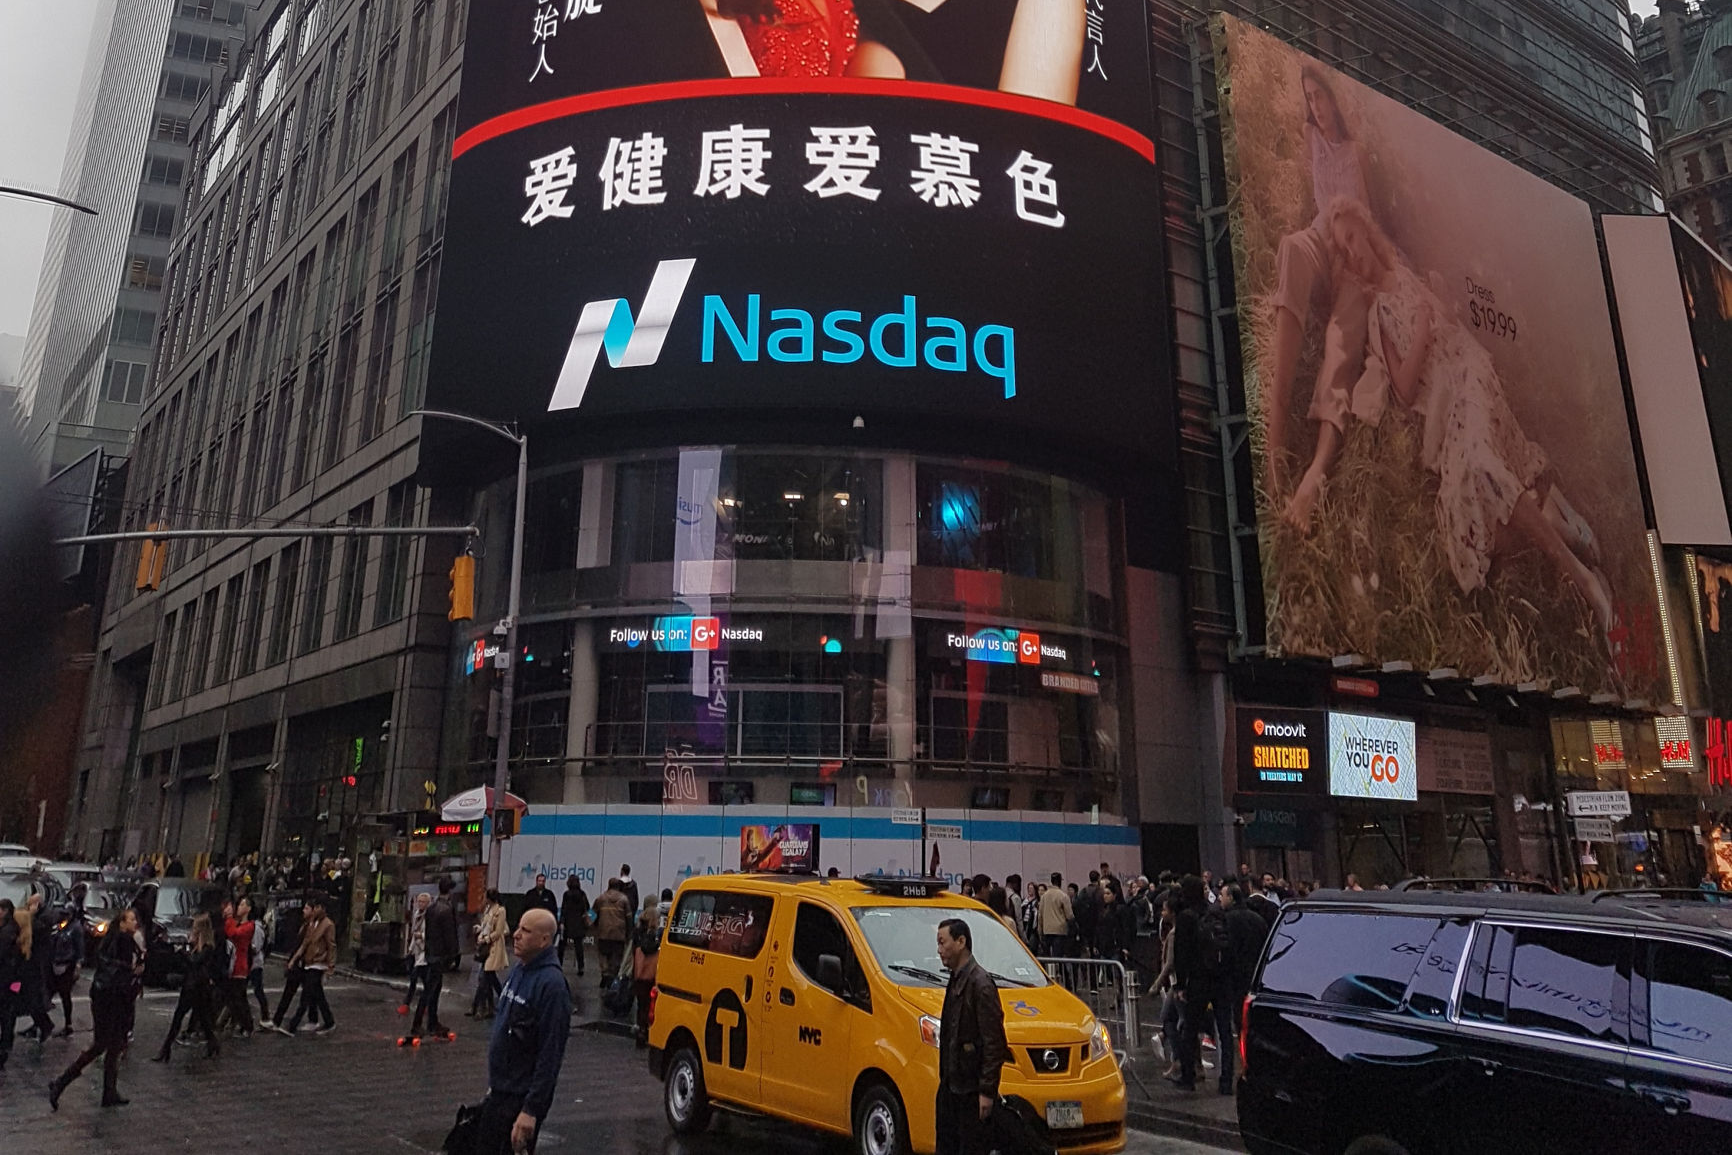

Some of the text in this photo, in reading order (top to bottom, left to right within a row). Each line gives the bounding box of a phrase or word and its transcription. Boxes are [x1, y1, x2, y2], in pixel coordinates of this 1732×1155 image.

[520, 122, 1066, 229] 爱健康爱慕色
[1465, 276, 1496, 304] Dress
[1469, 299, 1517, 343] $19.99
[699, 293, 1017, 399] Nasdaq
[610, 627, 648, 643] Follow
[651, 630, 665, 641] us
[668, 629, 688, 641] on:
[721, 628, 763, 642] Nasdaq
[948, 634, 985, 650] Follow
[988, 639, 1000, 651] us
[1002, 641, 1018, 653] on:
[1041, 645, 1067, 661] Nasdaq
[1042, 674, 1080, 690] BRANDED
[1265, 724, 1307, 738] moovit
[1345, 736, 1399, 755] WHEREVER
[1254, 747, 1310, 769] SNATCHED
[1347, 751, 1399, 784] YOU GO
[540, 863, 595, 885] Nasdaq
[799, 1025, 822, 1046] NYC
